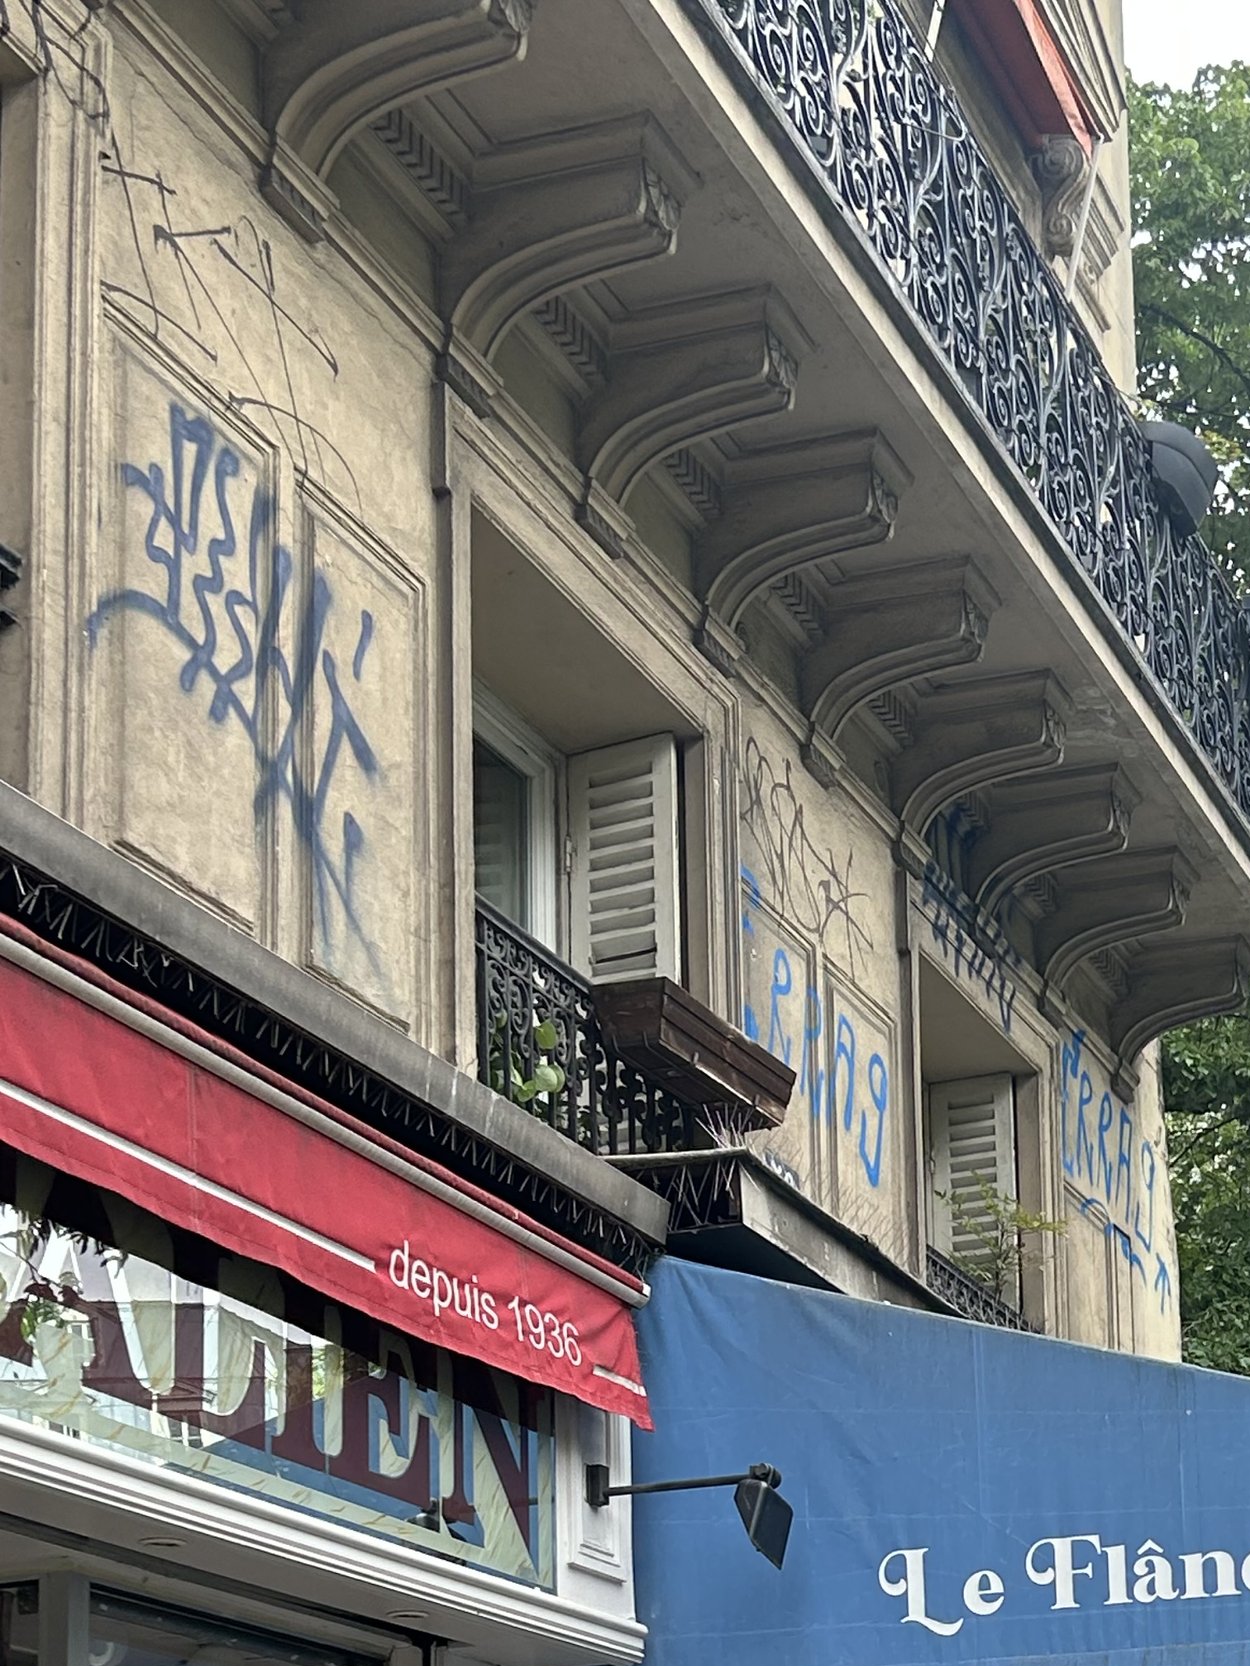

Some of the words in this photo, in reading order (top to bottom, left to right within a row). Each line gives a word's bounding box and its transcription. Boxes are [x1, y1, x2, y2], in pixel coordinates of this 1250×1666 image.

[388, 1239, 499, 1330] depuis
[507, 1295, 582, 1367] 1936
[878, 1546, 1006, 1637] Le
